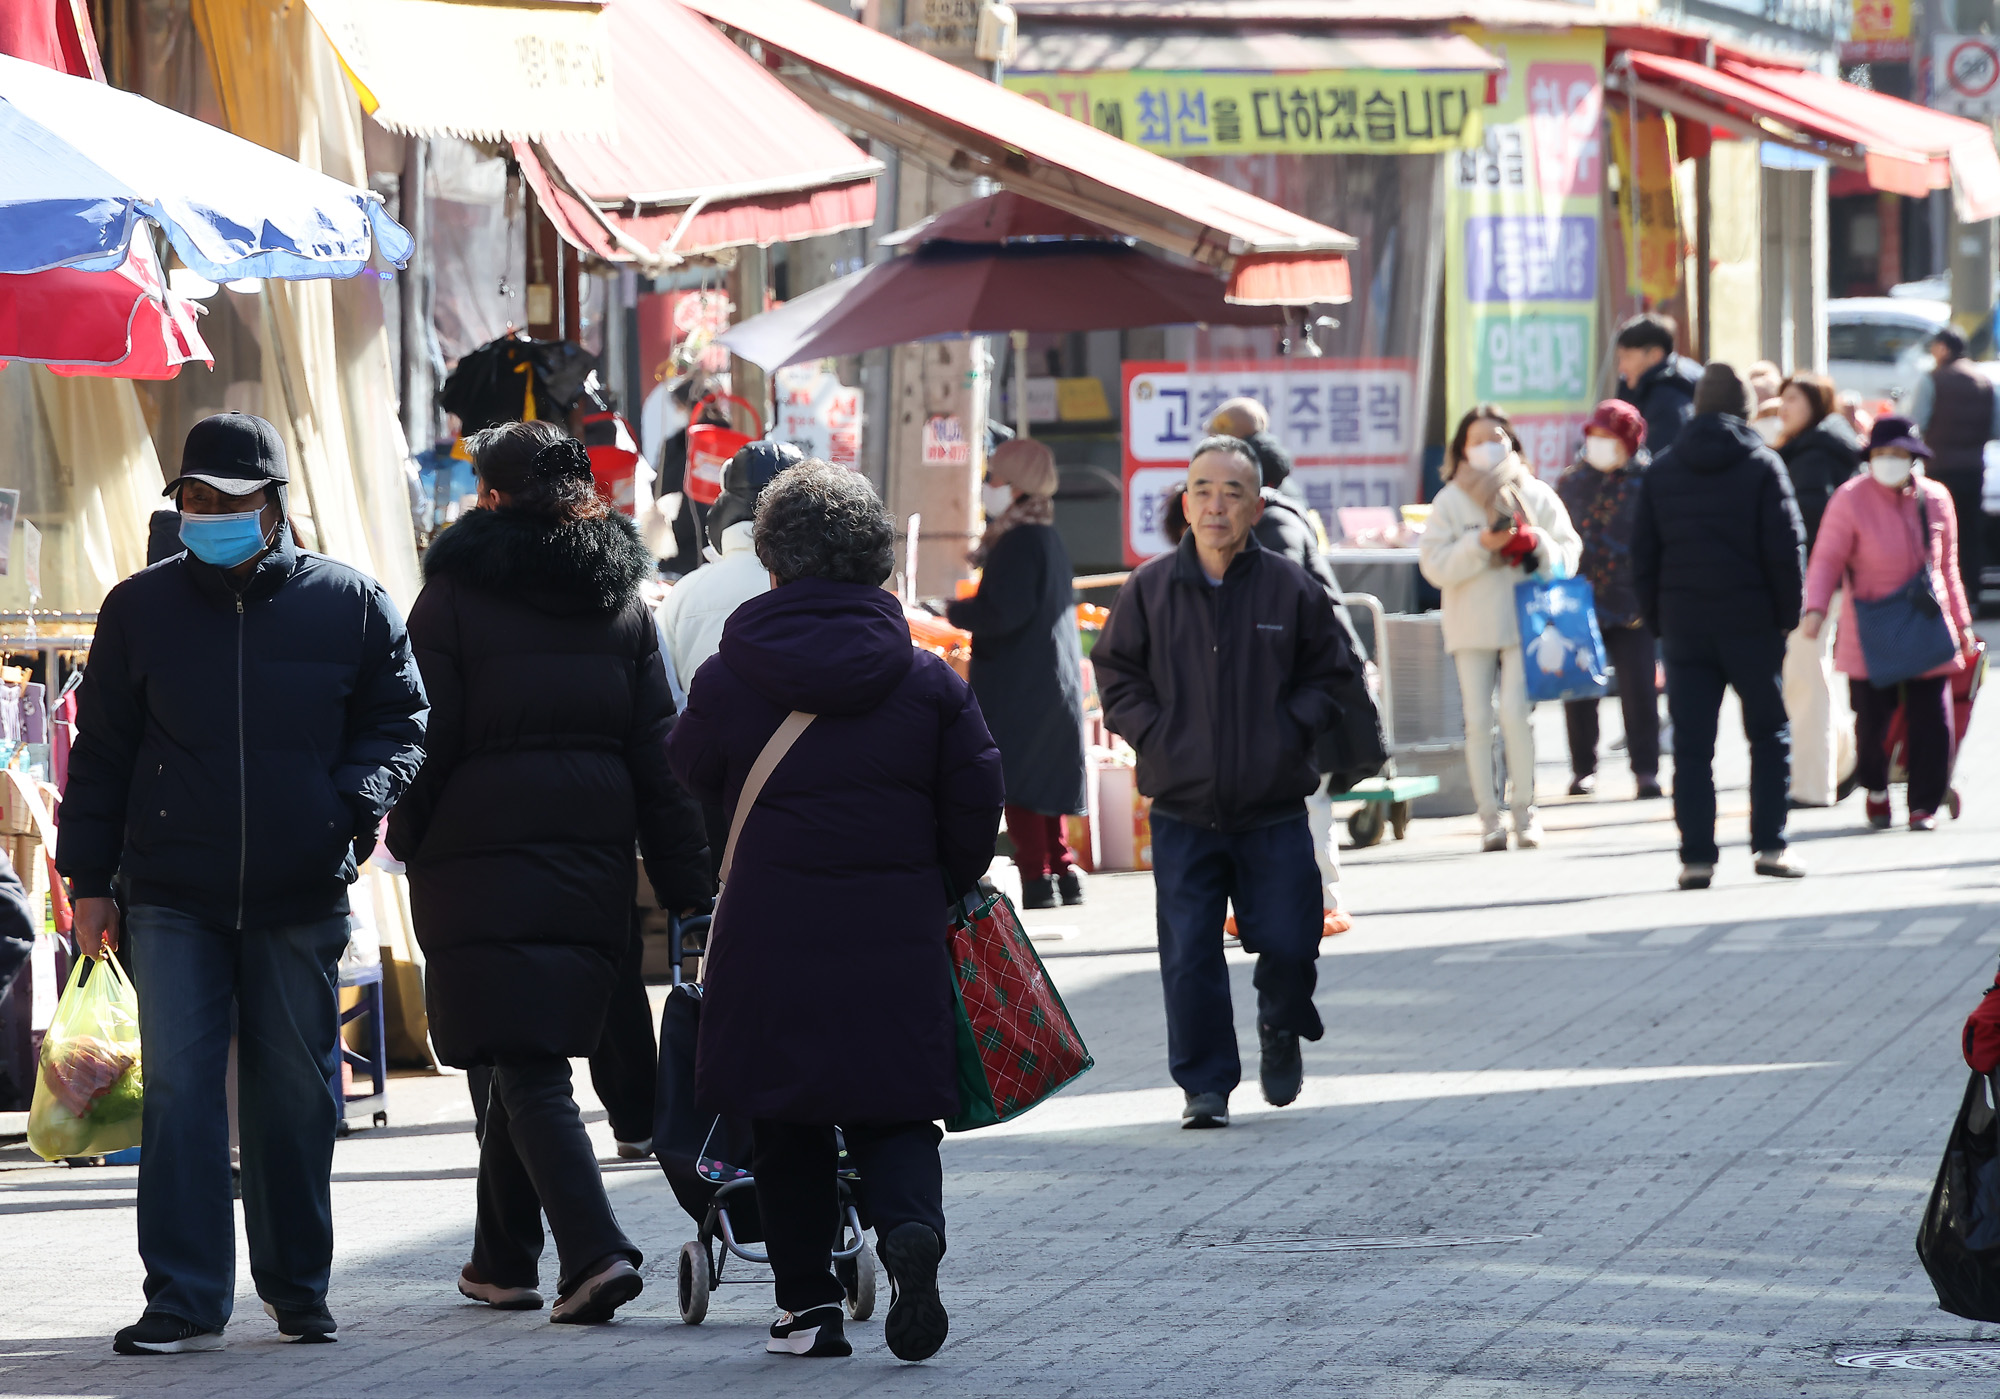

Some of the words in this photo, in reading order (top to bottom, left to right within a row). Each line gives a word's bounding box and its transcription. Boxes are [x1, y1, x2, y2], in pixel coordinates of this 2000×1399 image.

[1134, 88, 1243, 143] 최선을
[1252, 88, 1468, 140] 다하겠습니다
[1287, 385, 1402, 443] 주물럭
